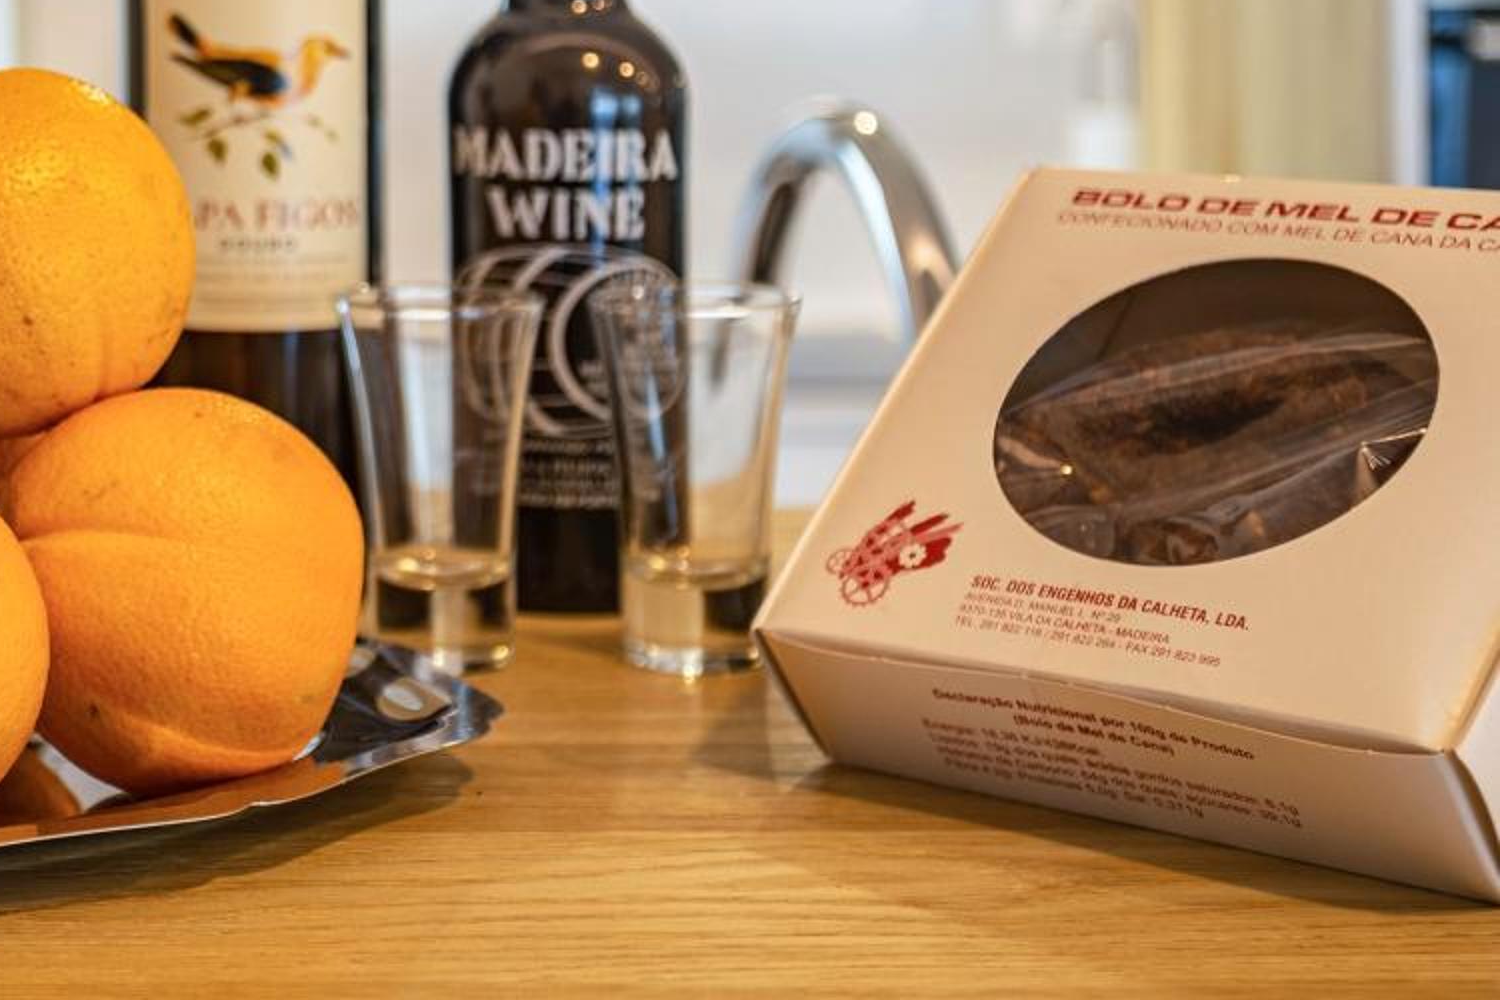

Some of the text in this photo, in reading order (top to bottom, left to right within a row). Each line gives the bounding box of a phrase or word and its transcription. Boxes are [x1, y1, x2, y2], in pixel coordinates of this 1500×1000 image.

[453, 127, 679, 182] MADEIRA
[485, 186, 645, 240] WINE
[1072, 190, 1191, 212] BOLO
[1198, 197, 1259, 217] DE
[1265, 202, 1360, 223] MEL
[1371, 207, 1441, 228] DE
[1059, 213, 1222, 233] CONFECIONADO
[1227, 220, 1279, 237] COM
[1283, 223, 1327, 240] MEL
[1332, 227, 1364, 243] DE
[1370, 230, 1433, 249] CANA
[1439, 235, 1471, 250] DA
[1006, 578, 1036, 596] DOS
[1037, 584, 1116, 608] ENGENHOS
[1118, 594, 1138, 610] DA
[1141, 599, 1210, 625] CALHETA,
[1215, 611, 1250, 631] LDA.
[1054, 617, 1106, 635] CALHETA
[1115, 625, 1171, 644] MADEIRA
[1125, 642, 1148, 655] FAX
